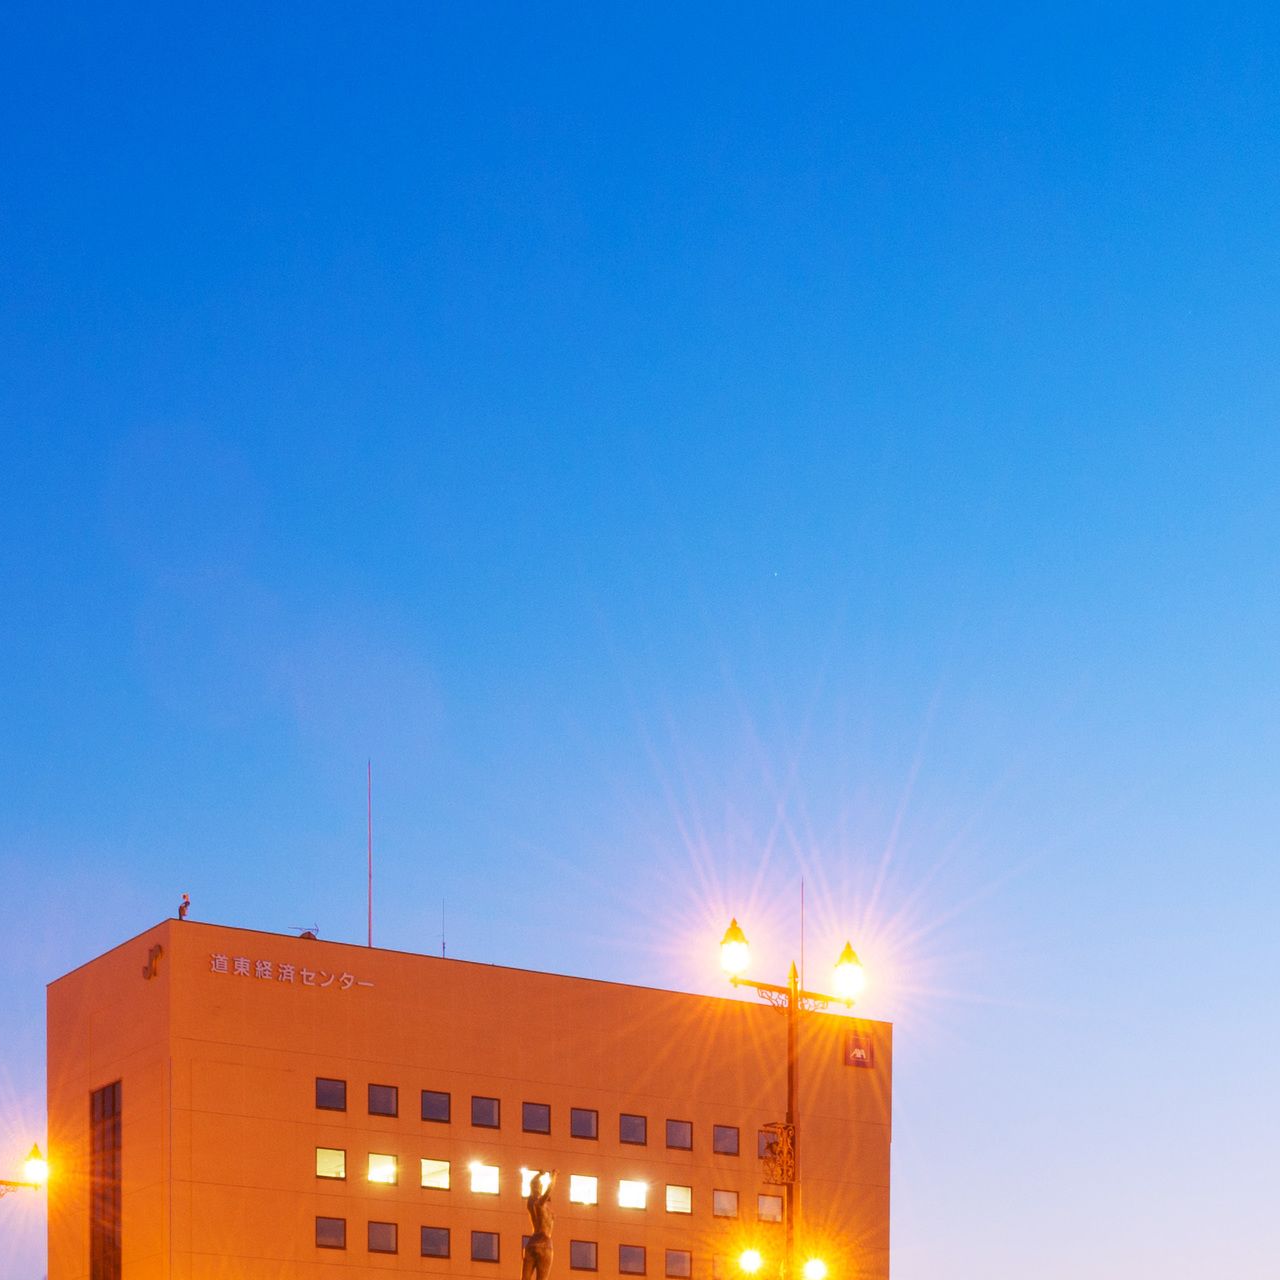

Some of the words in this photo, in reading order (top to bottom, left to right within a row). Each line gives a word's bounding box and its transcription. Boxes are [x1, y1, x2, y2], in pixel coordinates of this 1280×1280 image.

[210, 953, 375, 990] 道東経済センター
